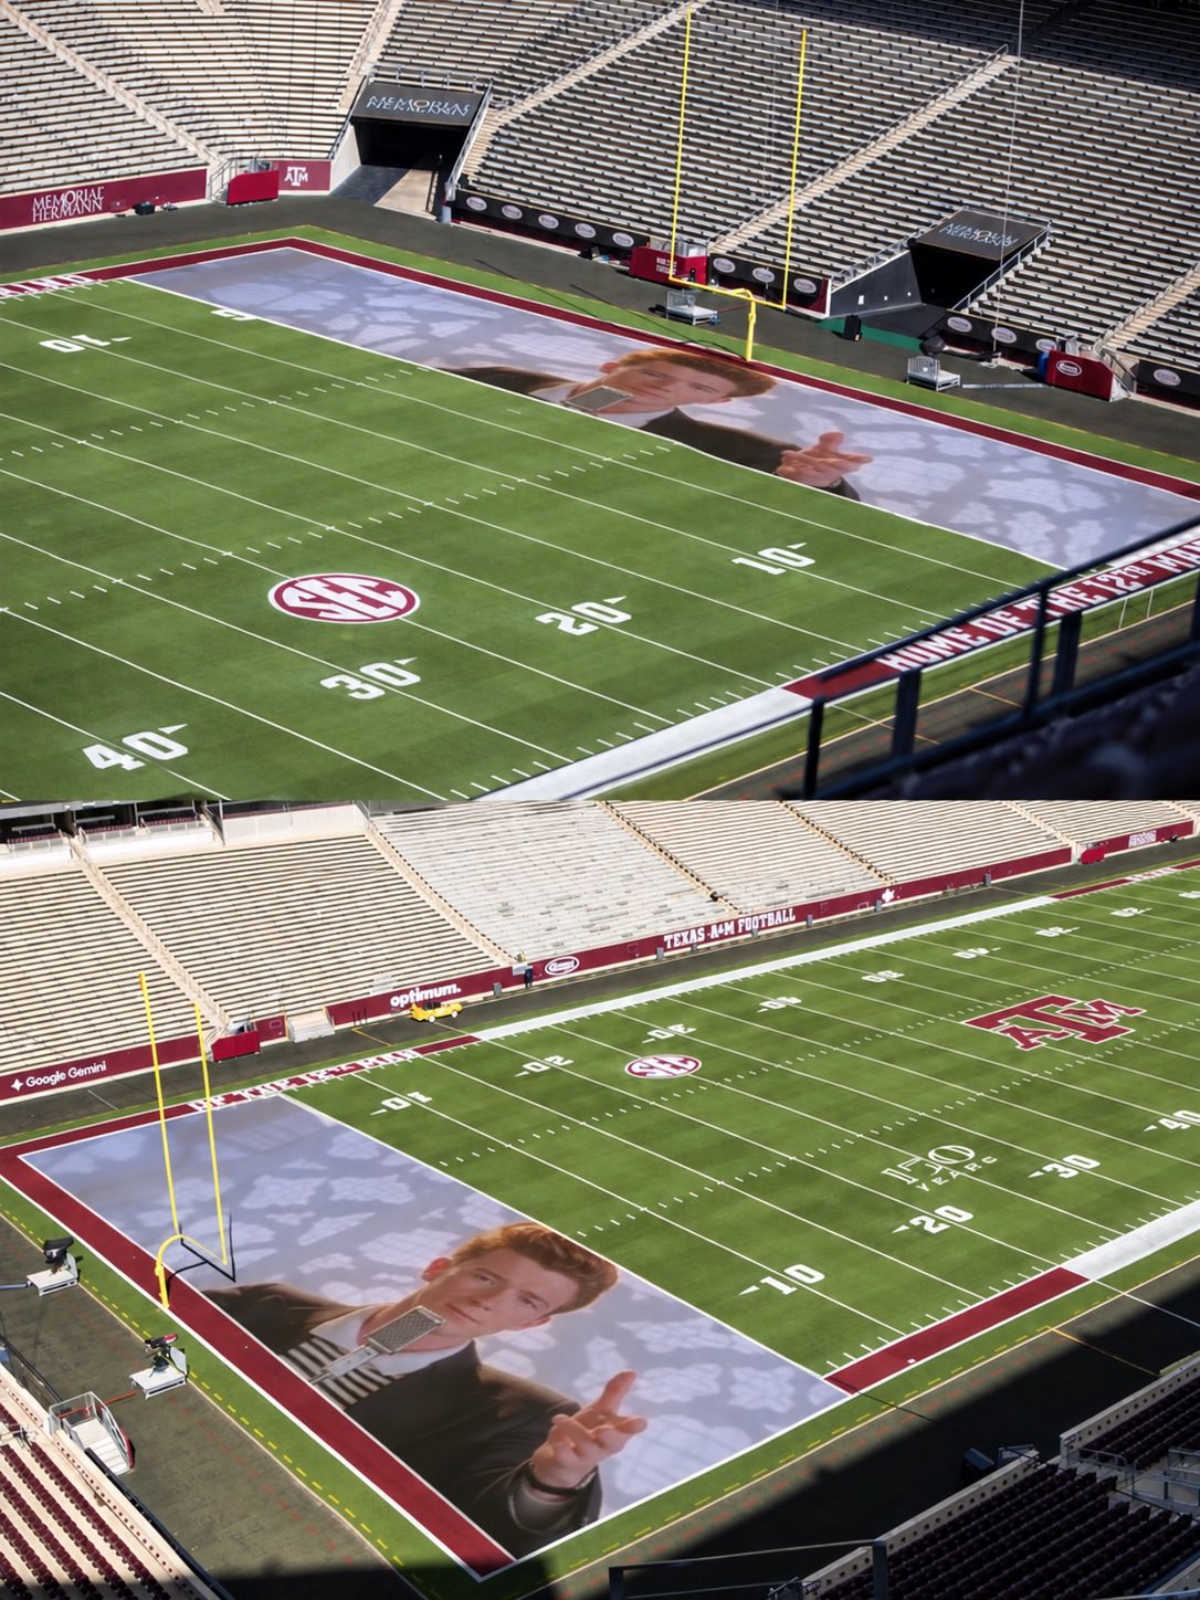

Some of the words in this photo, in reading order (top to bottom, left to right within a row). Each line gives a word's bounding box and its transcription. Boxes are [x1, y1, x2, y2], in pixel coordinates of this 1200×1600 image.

[32, 198, 104, 222] HERMANN
[33, 187, 104, 212] MEMORIAL
[731, 547, 816, 575] 10
[274, 574, 413, 622] SEC
[535, 601, 632, 636] 20
[320, 662, 421, 700] 30
[82, 731, 189, 771] 40
[663, 927, 705, 949] TEXAS
[737, 908, 796, 933] FOOTBALL
[390, 984, 461, 1008] optimum.
[26, 1071, 66, 1088] Google
[67, 1060, 107, 1079] Gemini
[630, 1056, 699, 1077] SEC
[1042, 1155, 1101, 1179] 30
[909, 1206, 974, 1234] 20
[759, 1264, 825, 1295] 10
